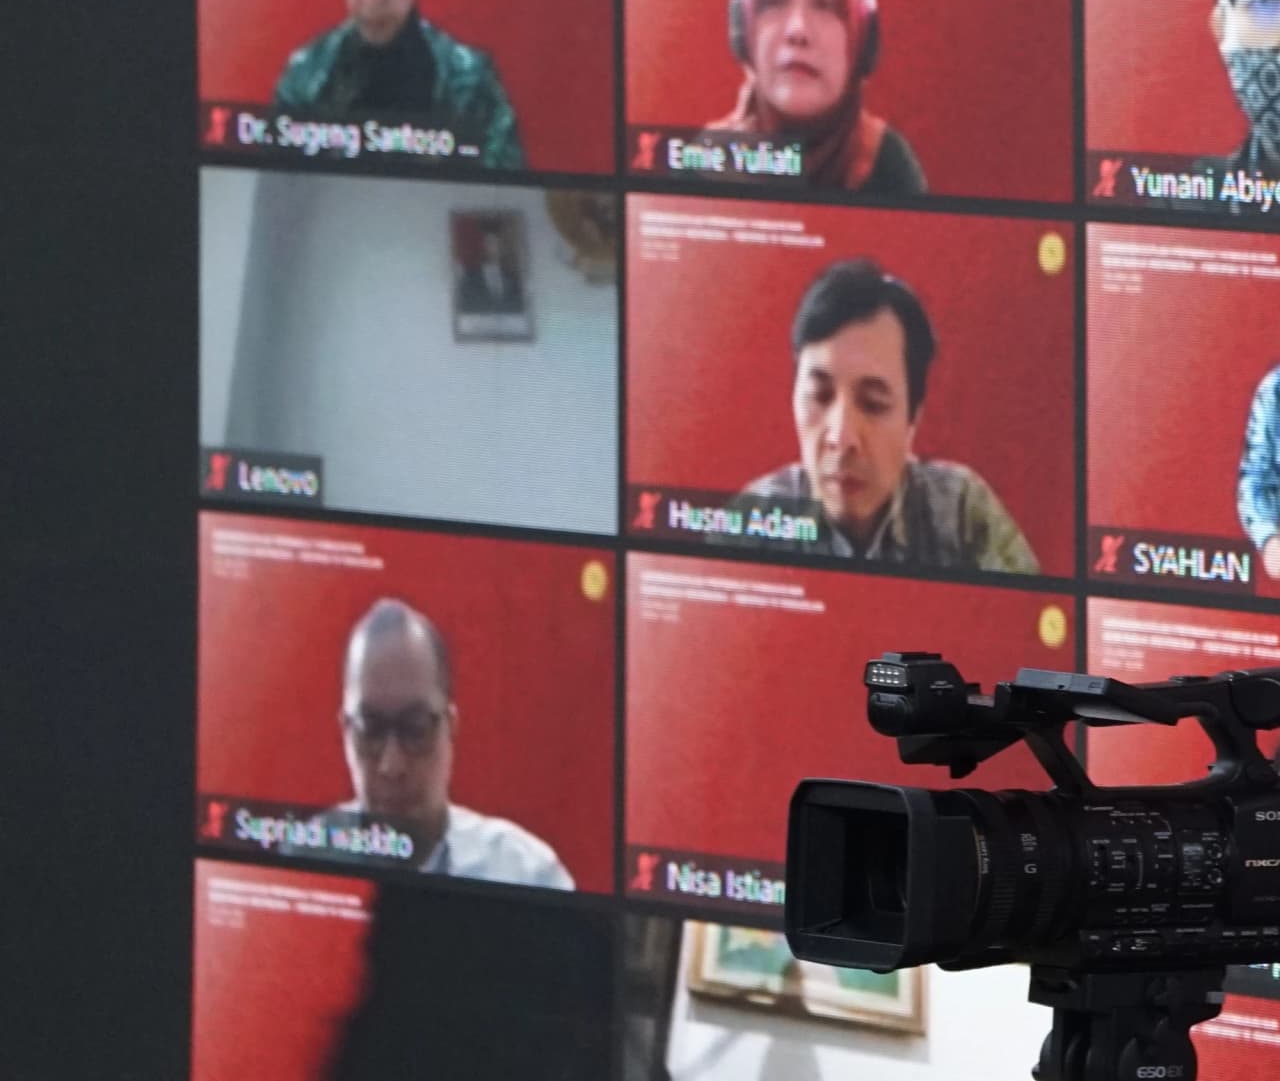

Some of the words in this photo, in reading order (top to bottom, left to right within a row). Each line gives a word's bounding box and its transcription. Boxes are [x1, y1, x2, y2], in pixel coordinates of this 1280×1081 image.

[237, 112, 273, 145] Dr.
[276, 114, 362, 159] Sugeng
[363, 119, 456, 157] Santoso
[667, 137, 727, 172] Emie
[730, 141, 803, 177] Yuliati
[1131, 164, 1215, 201] Yunani
[238, 460, 319, 498] Lenovo
[668, 499, 743, 536] Husnu
[746, 505, 818, 543] Adam
[1133, 541, 1250, 584] SYAHLAN
[234, 807, 328, 849] Supriadi
[666, 861, 722, 899] Nisa
